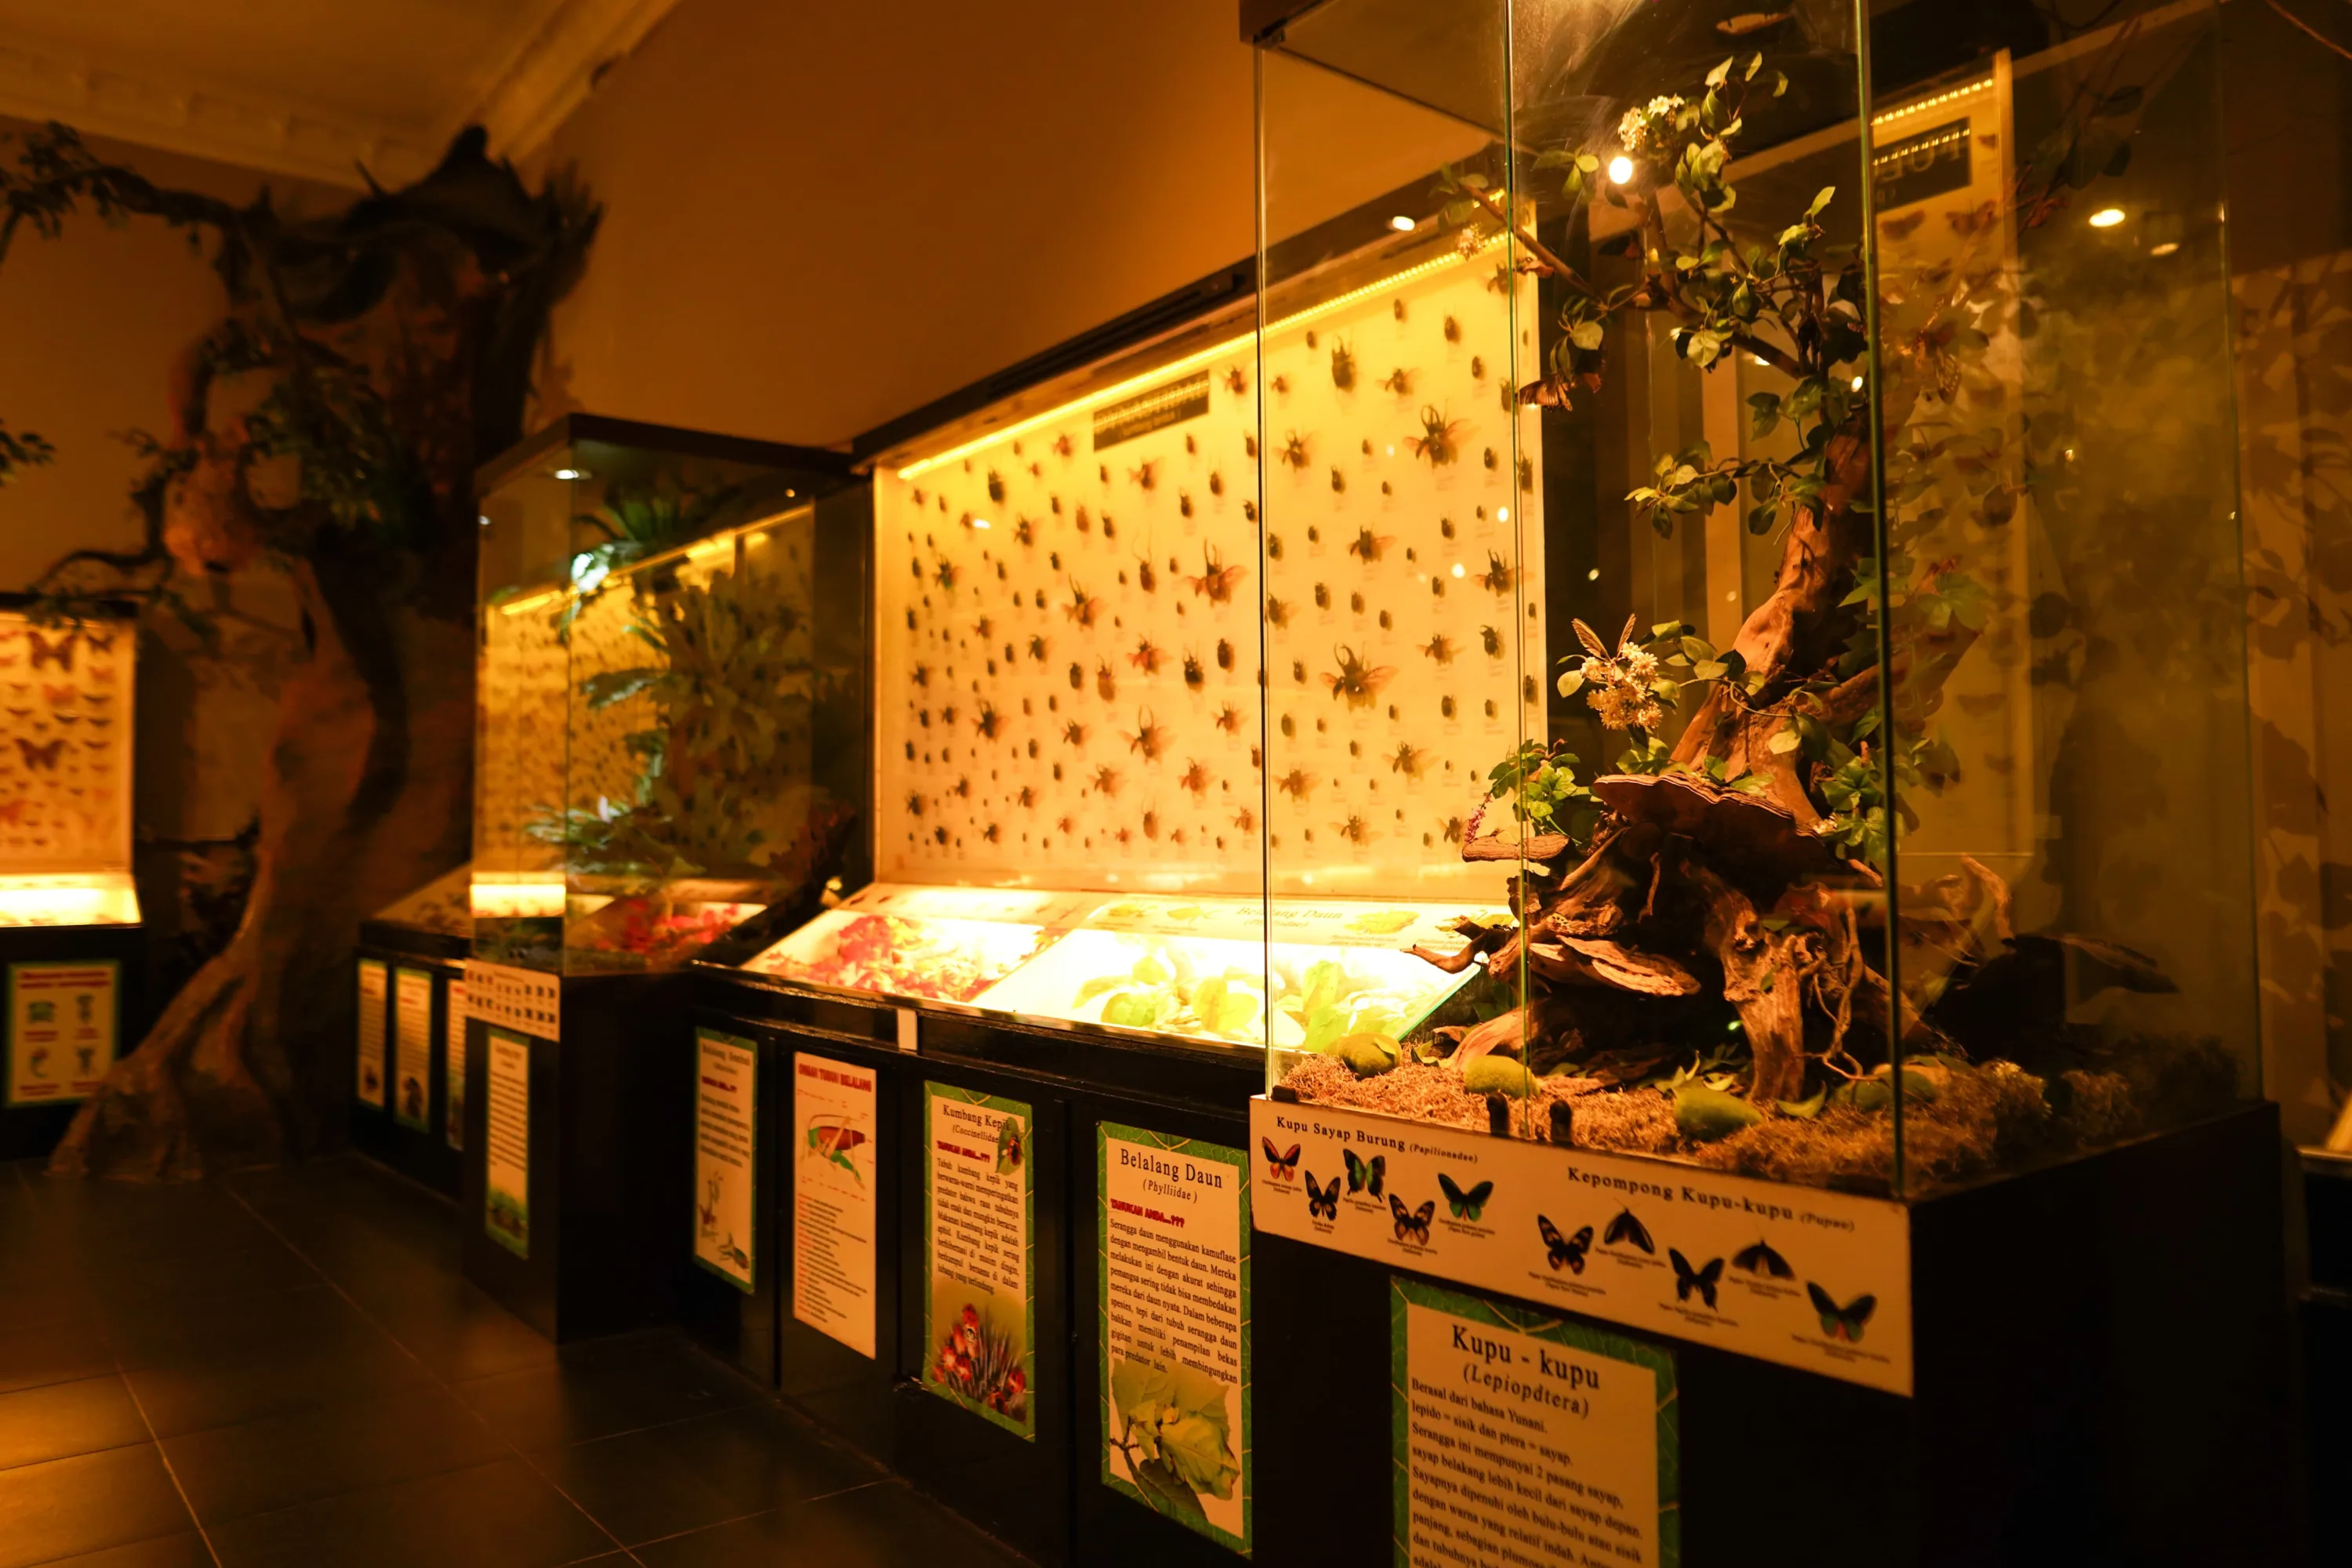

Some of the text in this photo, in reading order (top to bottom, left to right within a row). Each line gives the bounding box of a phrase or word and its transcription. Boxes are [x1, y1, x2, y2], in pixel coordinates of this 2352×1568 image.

[943, 1105, 1011, 1131] Kumbang Kepik
[1276, 1116, 1308, 1134] Kupu
[1313, 1123, 1351, 1142] Sayap
[1356, 1130, 1405, 1152] Burung
[1120, 1148, 1223, 1189] Belalang Daun
[1568, 1167, 1674, 1201] Kepompong
[1681, 1186, 1793, 1221] Kupu-kupu
[1110, 1218, 1236, 1263] Serangga daun menggunakan kamuflase
[1110, 1235, 1131, 1249] dengan
[1132, 1243, 1166, 1259] mengambil
[1167, 1251, 1189, 1266] bentuk
[1210, 1265, 1236, 1281] Mereka
[1110, 1251, 1142, 1268] melakukan
[1156, 1264, 1179, 1279] dengan
[1182, 1273, 1203, 1287] akurat
[1206, 1282, 1236, 1299] sehingga
[1110, 1268, 1236, 1315] pemangsa sering tidak bisa membedakan
[1110, 1283, 1131, 1296] mereka
[1133, 1288, 1145, 1300] dari
[1146, 1293, 1161, 1306] daun
[1183, 1305, 1204, 1321] Dalam
[1206, 1313, 1236, 1334] beberapa
[1136, 1306, 1148, 1319] tepi
[1151, 1310, 1163, 1323] dari
[1166, 1316, 1184, 1330] tubuh
[1187, 1327, 1217, 1343] serangga
[1220, 1335, 1237, 1349] daun
[1111, 1312, 1237, 1367] bahkan memiliki penampilan bekas
[1111, 1345, 1124, 1356] para
[1124, 1351, 1150, 1366] predator
[1111, 1329, 1237, 1384] gigitan untuk lebih membingungkan
[1453, 1324, 1511, 1364] Kupu
[1540, 1348, 1599, 1390] kupu
[1464, 1363, 1589, 1420] (Lepiopdtera)
[1537, 1465, 1542, 1478] 2
